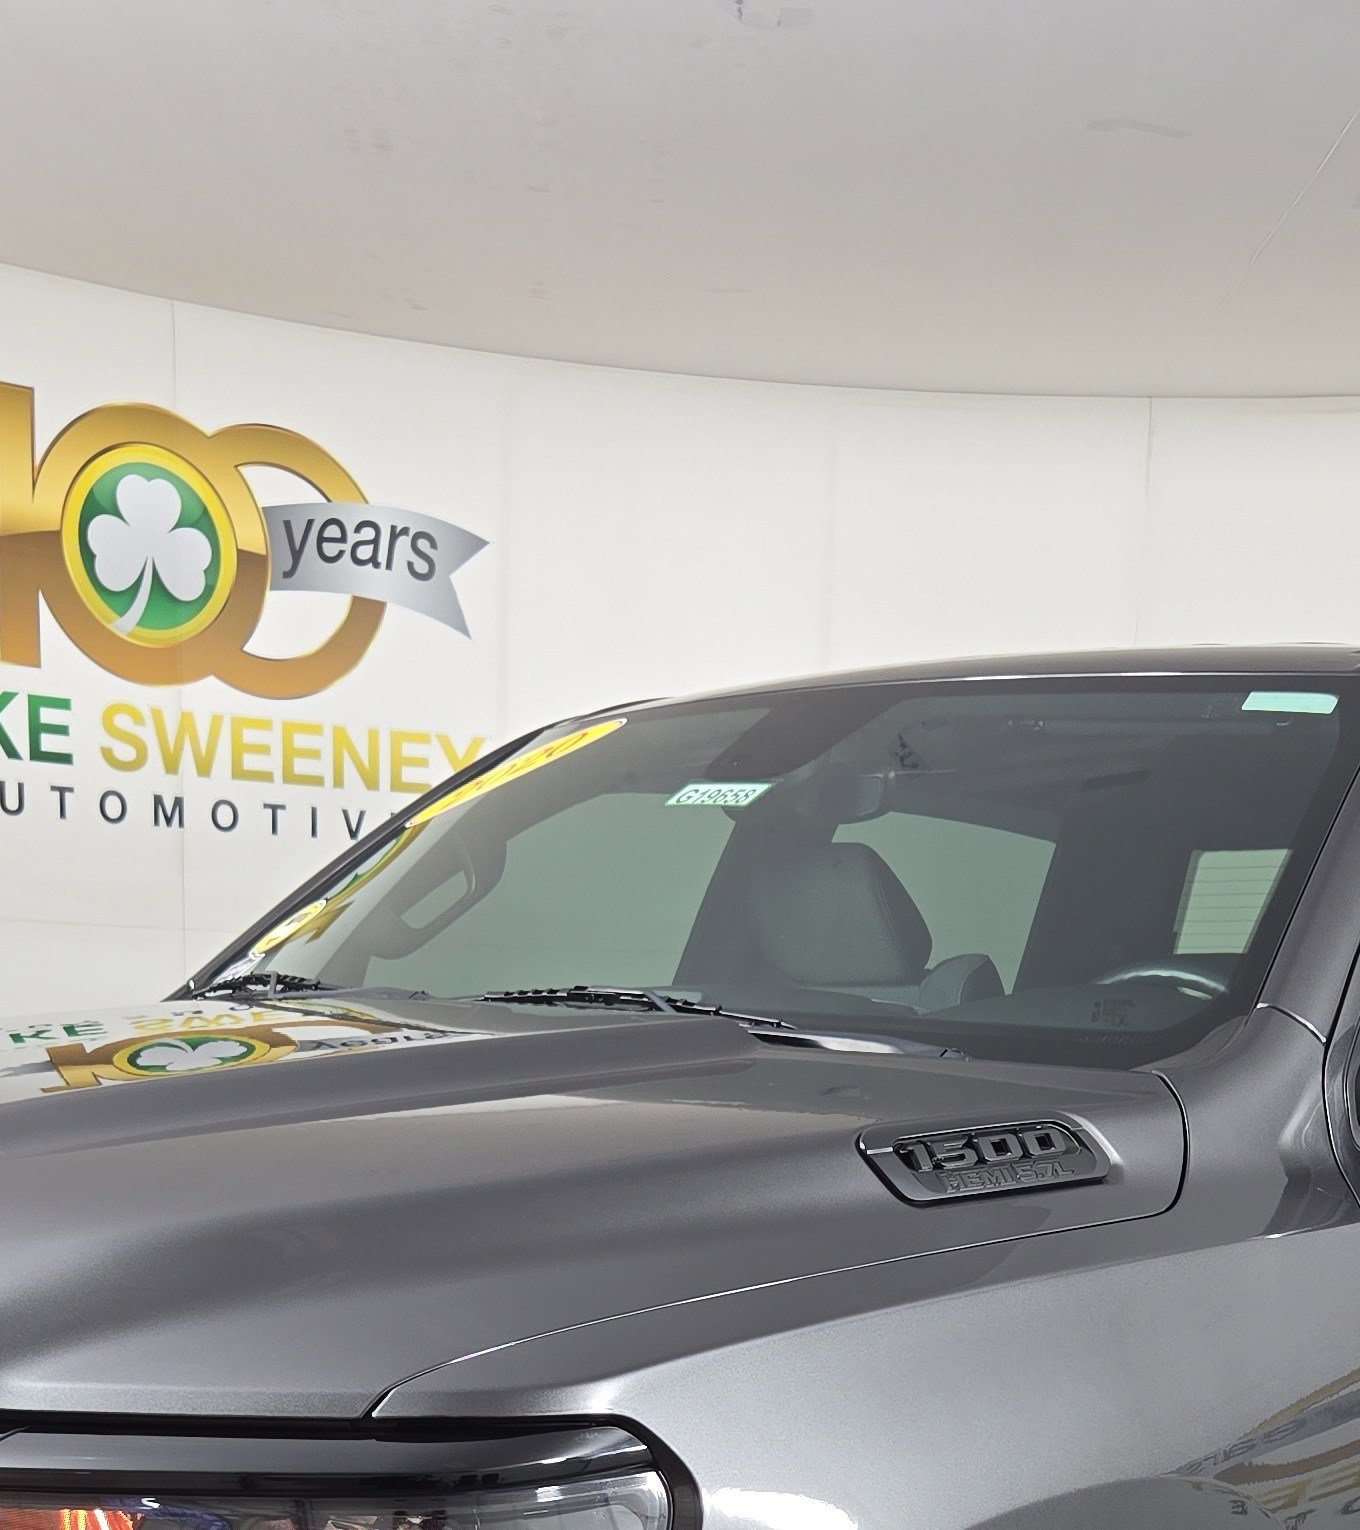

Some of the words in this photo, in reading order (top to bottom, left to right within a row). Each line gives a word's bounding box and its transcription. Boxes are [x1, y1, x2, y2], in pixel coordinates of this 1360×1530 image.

[282, 515, 438, 581] years
[675, 788, 757, 804] G19658
[899, 1127, 1067, 1172] 1500
